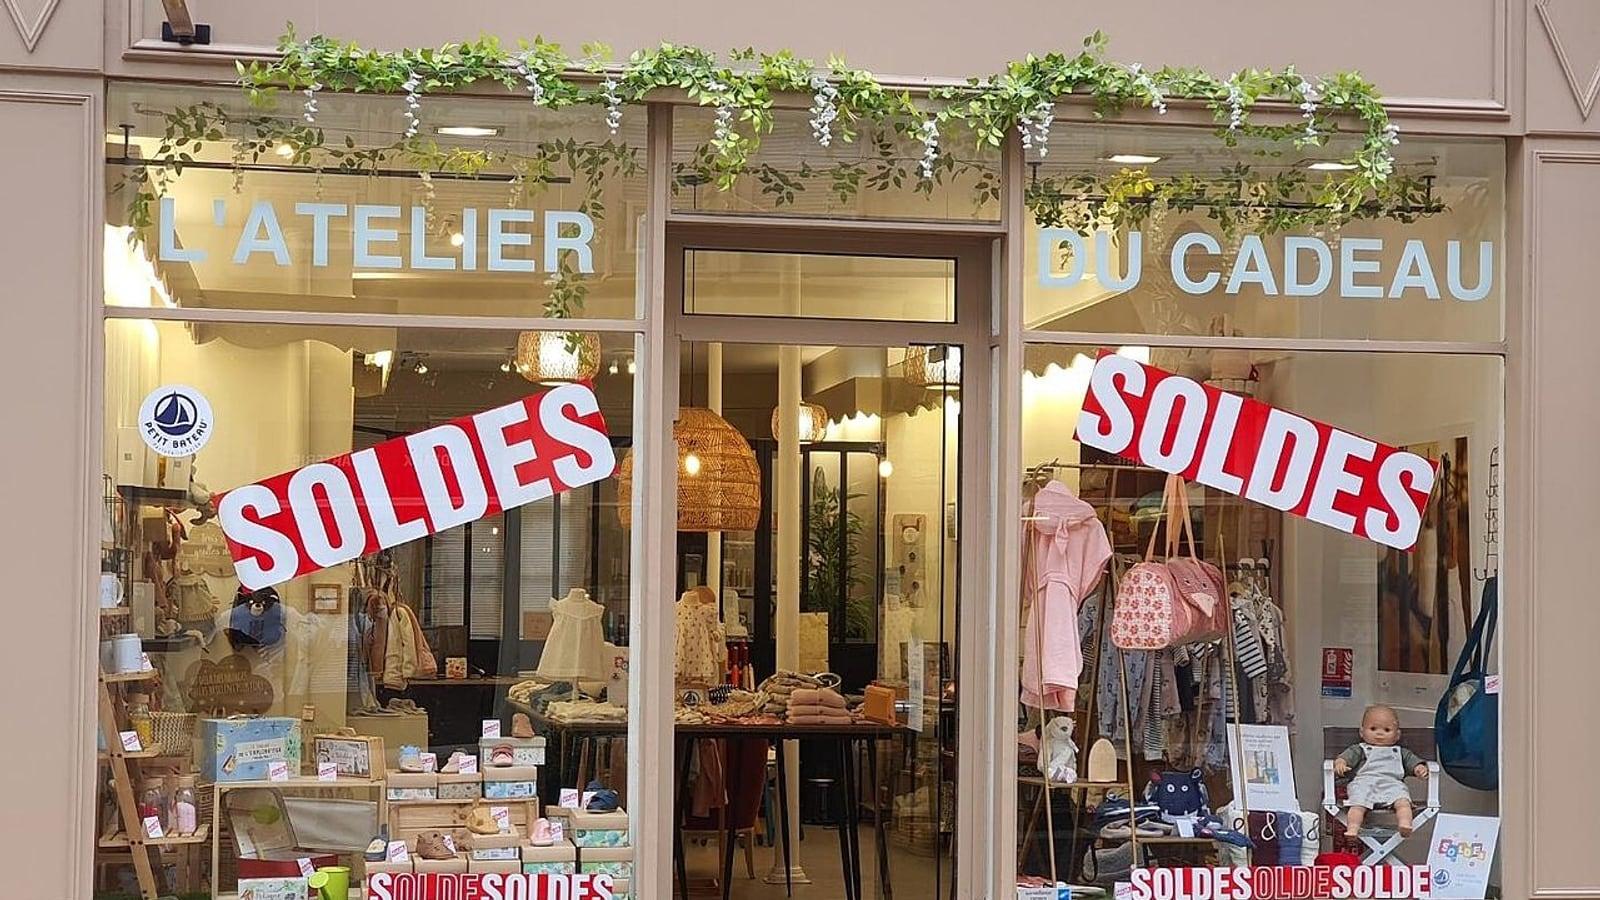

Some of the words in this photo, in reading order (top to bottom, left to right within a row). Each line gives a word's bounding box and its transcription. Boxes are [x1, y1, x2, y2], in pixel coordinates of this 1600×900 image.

[159, 197, 596, 275] L'ATELIER
[1036, 227, 1143, 292] DU
[1170, 231, 1494, 302] CADEAU
[144, 421, 169, 447] PETIT
[172, 420, 208, 449] BATEAU
[1075, 353, 1437, 551] SOLDES
[217, 382, 617, 592] SOLDES
